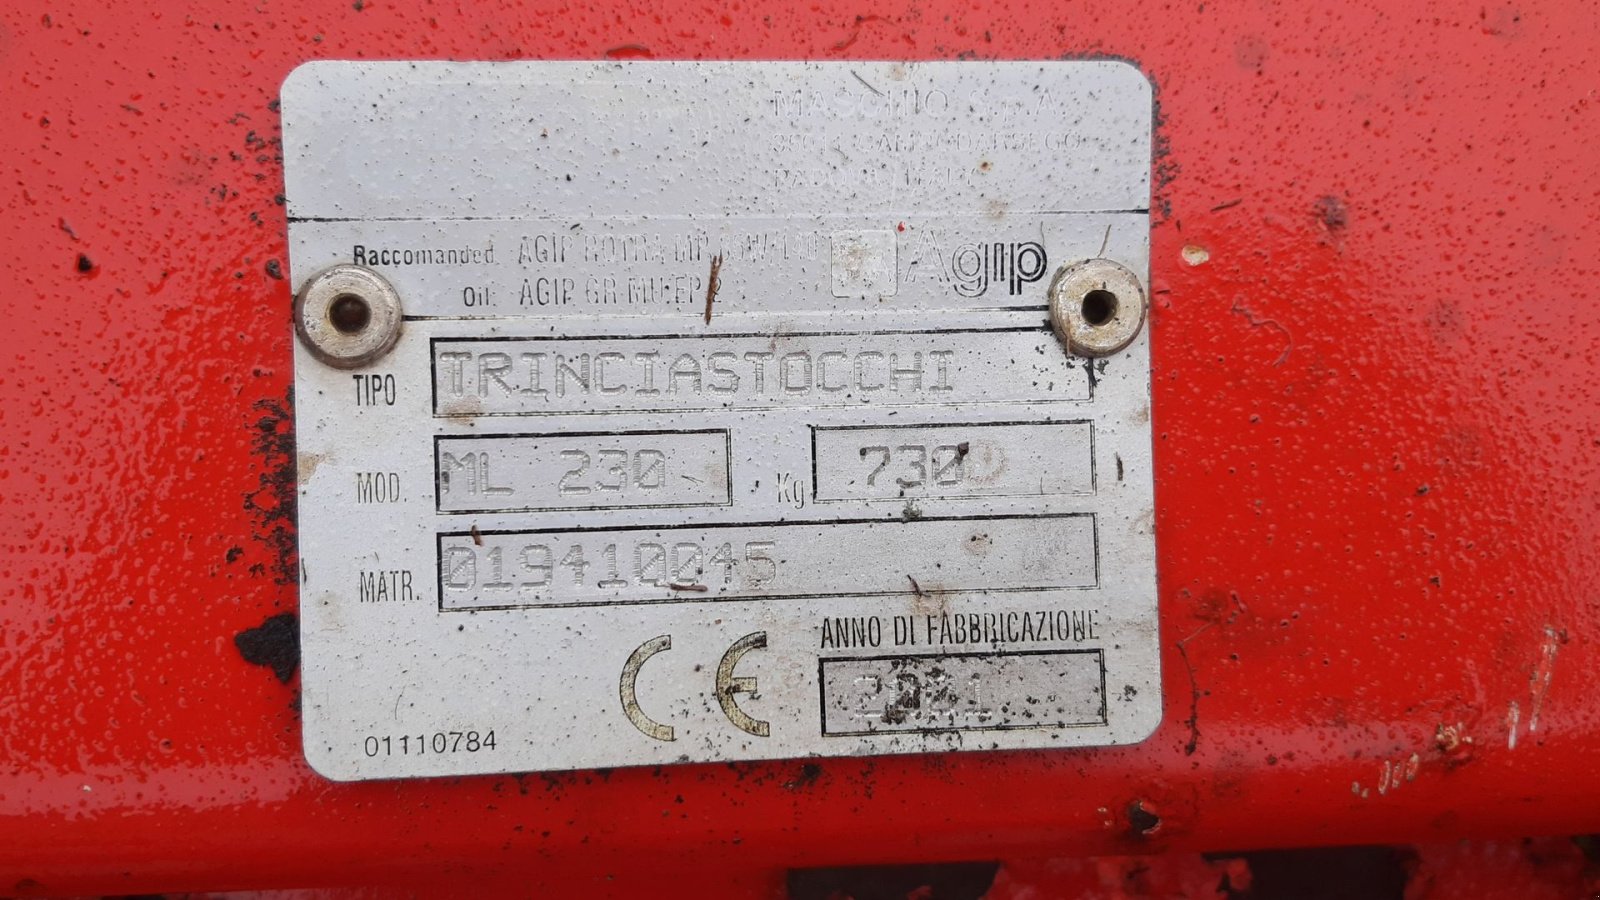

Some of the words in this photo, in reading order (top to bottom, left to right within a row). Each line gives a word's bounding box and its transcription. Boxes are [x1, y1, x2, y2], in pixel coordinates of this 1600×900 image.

[774, 89, 949, 117] MASCHIO
[353, 244, 494, 266] Raccomanded
[518, 235, 573, 264] AGIP
[584, 234, 665, 263] ROTRA
[674, 233, 709, 262] MP
[904, 230, 1048, 298] Agip
[519, 277, 575, 306] AGIP
[585, 276, 617, 305] GR
[352, 373, 396, 407] TIPO
[440, 350, 954, 399] TRINCIASTOCCHI
[441, 451, 515, 496] ML
[558, 449, 666, 495] 230
[859, 444, 966, 488] 730
[356, 471, 408, 504] MOD.
[777, 472, 804, 509] Kg
[442, 540, 778, 592] 019410045
[359, 569, 420, 602] MATR.
[820, 615, 881, 649] ANNO
[893, 614, 915, 646] DI
[926, 609, 1100, 645] FABBRICAZIONE
[364, 730, 497, 757] 01110784
